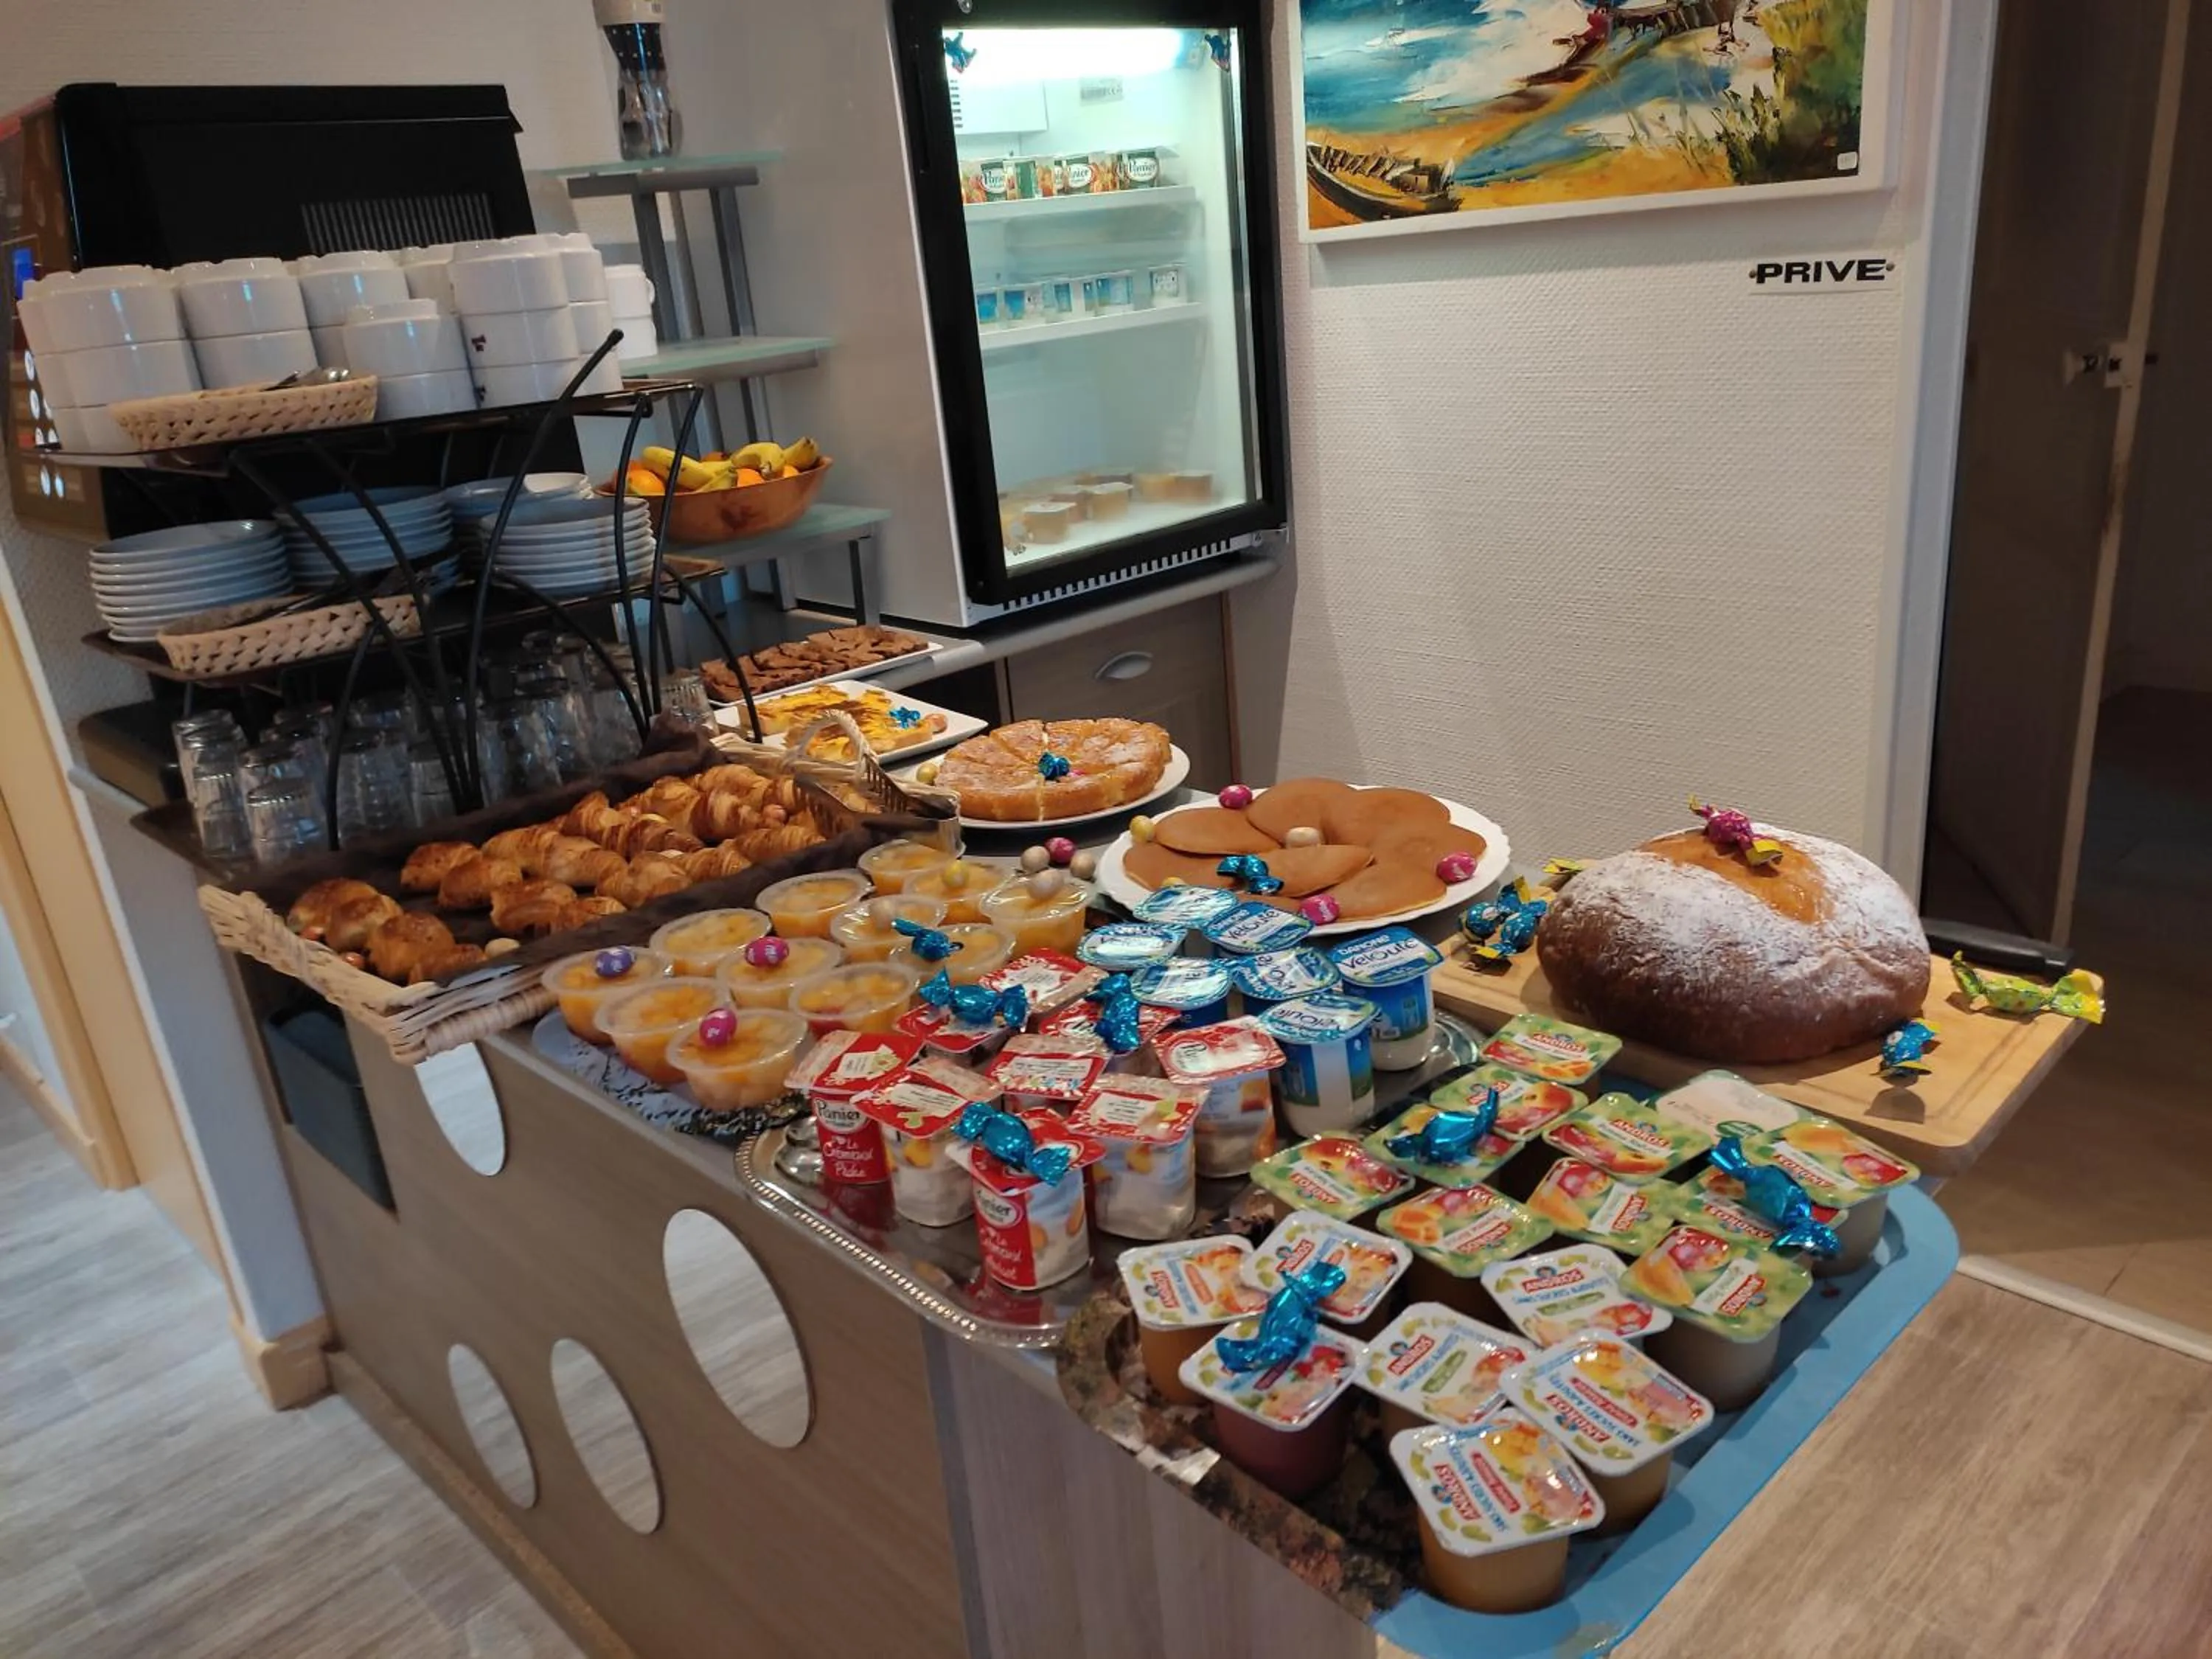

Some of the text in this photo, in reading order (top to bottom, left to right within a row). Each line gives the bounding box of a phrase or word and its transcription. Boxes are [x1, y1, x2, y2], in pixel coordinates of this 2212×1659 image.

[1756, 260, 1886, 284] PRIVE
[815, 1099, 860, 1119] Panier
[1610, 1119, 1670, 1150] ANDROS
[1525, 1270, 1583, 1291] ANDROS
[1546, 1394, 1607, 1441] ANDROS
[1435, 1464, 1479, 1521] ANDROS
